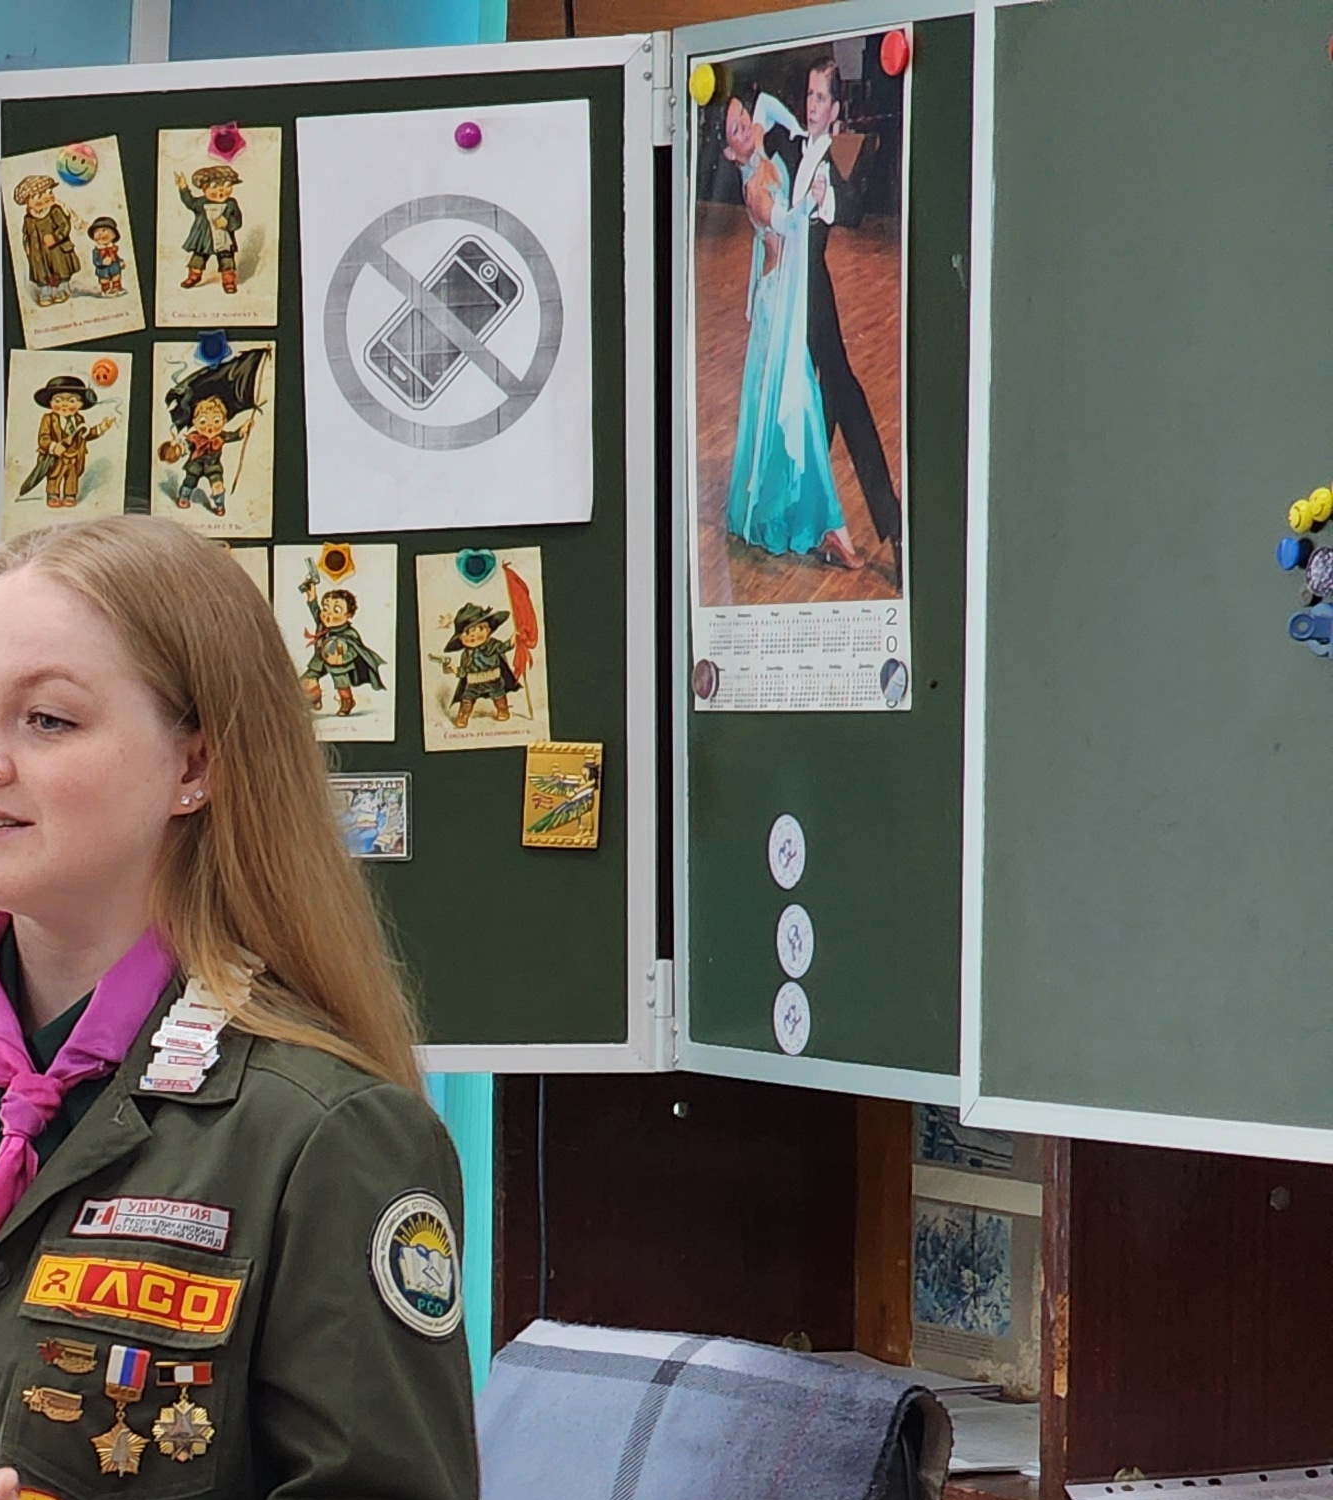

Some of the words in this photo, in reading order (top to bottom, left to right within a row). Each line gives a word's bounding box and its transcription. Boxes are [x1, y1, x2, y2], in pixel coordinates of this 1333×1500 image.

[127, 1200, 212, 1222] УДМУРТИЯ
[90, 1269, 220, 1324] ЛСО
[416, 1297, 444, 1316] РСО
